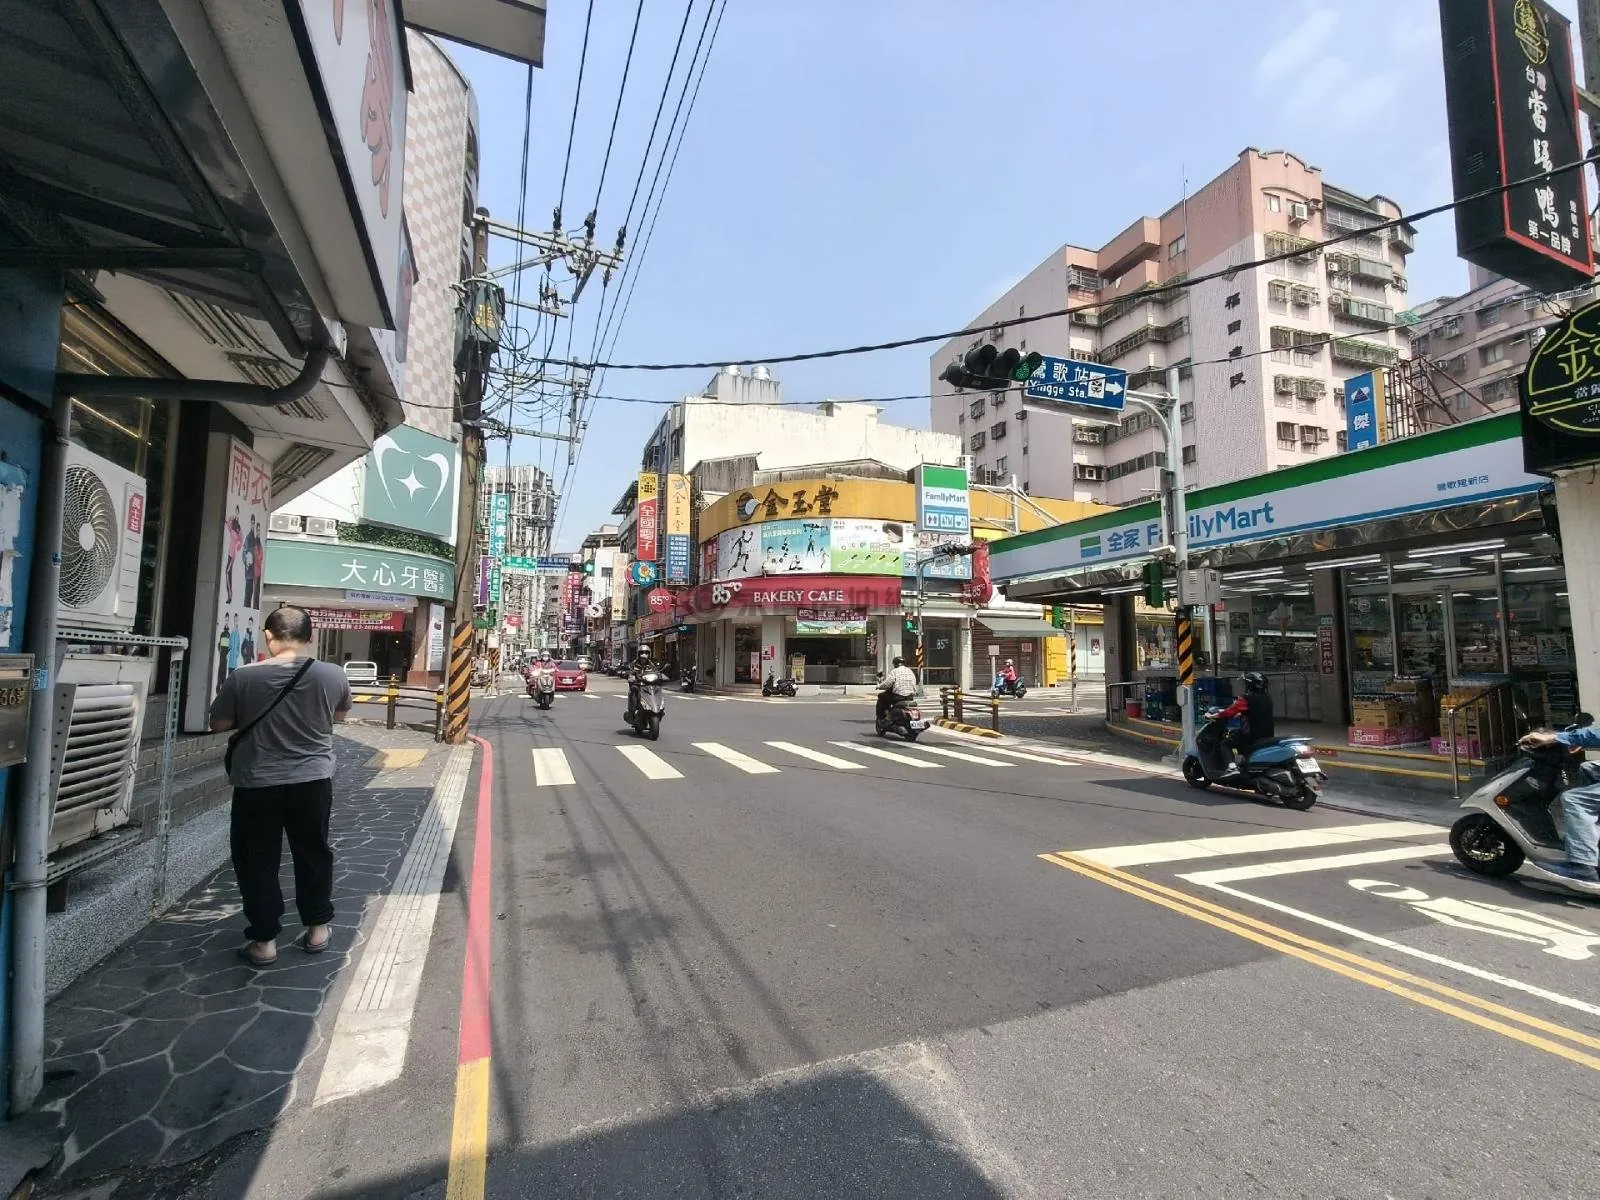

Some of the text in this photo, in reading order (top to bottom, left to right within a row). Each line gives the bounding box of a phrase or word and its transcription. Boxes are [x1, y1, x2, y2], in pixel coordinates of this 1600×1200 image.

[1068, 387, 1088, 399] Sta.
[230, 445, 271, 511] 雨衣
[760, 484, 839, 516] 金玉堂
[925, 491, 966, 503] FamilyMart
[1107, 501, 1275, 553] 全家 FilyMart
[340, 558, 439, 593] 大心牙醫
[753, 590, 844, 603] BAKERY CAFE
